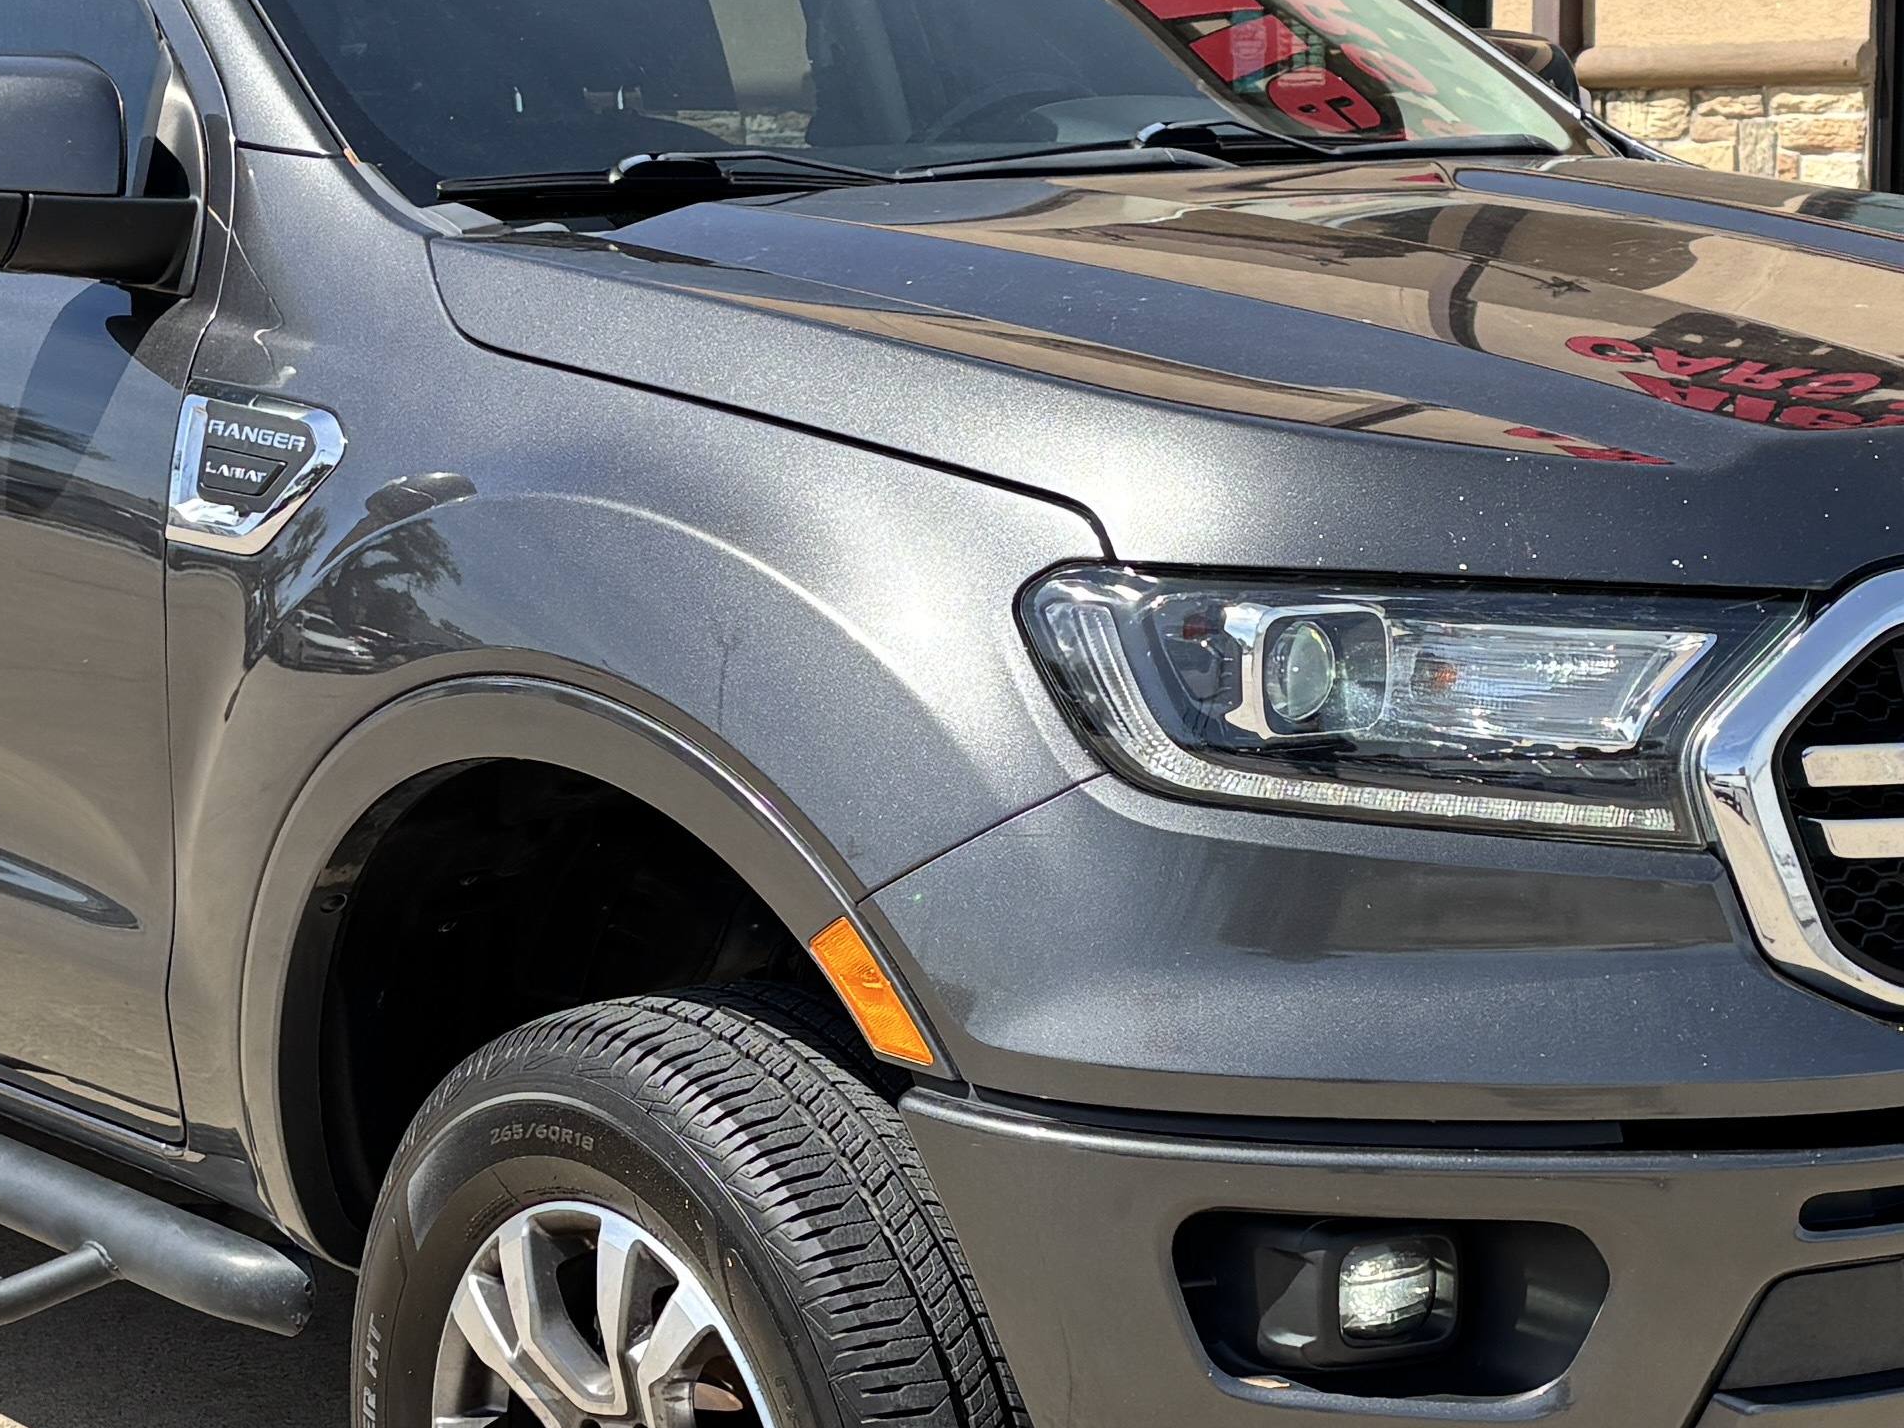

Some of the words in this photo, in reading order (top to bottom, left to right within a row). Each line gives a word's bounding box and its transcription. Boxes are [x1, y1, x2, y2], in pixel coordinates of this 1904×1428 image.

[207, 418, 307, 453] RANGER
[205, 461, 268, 484] LARIAT
[490, 1122, 595, 1152] 265/60R18
